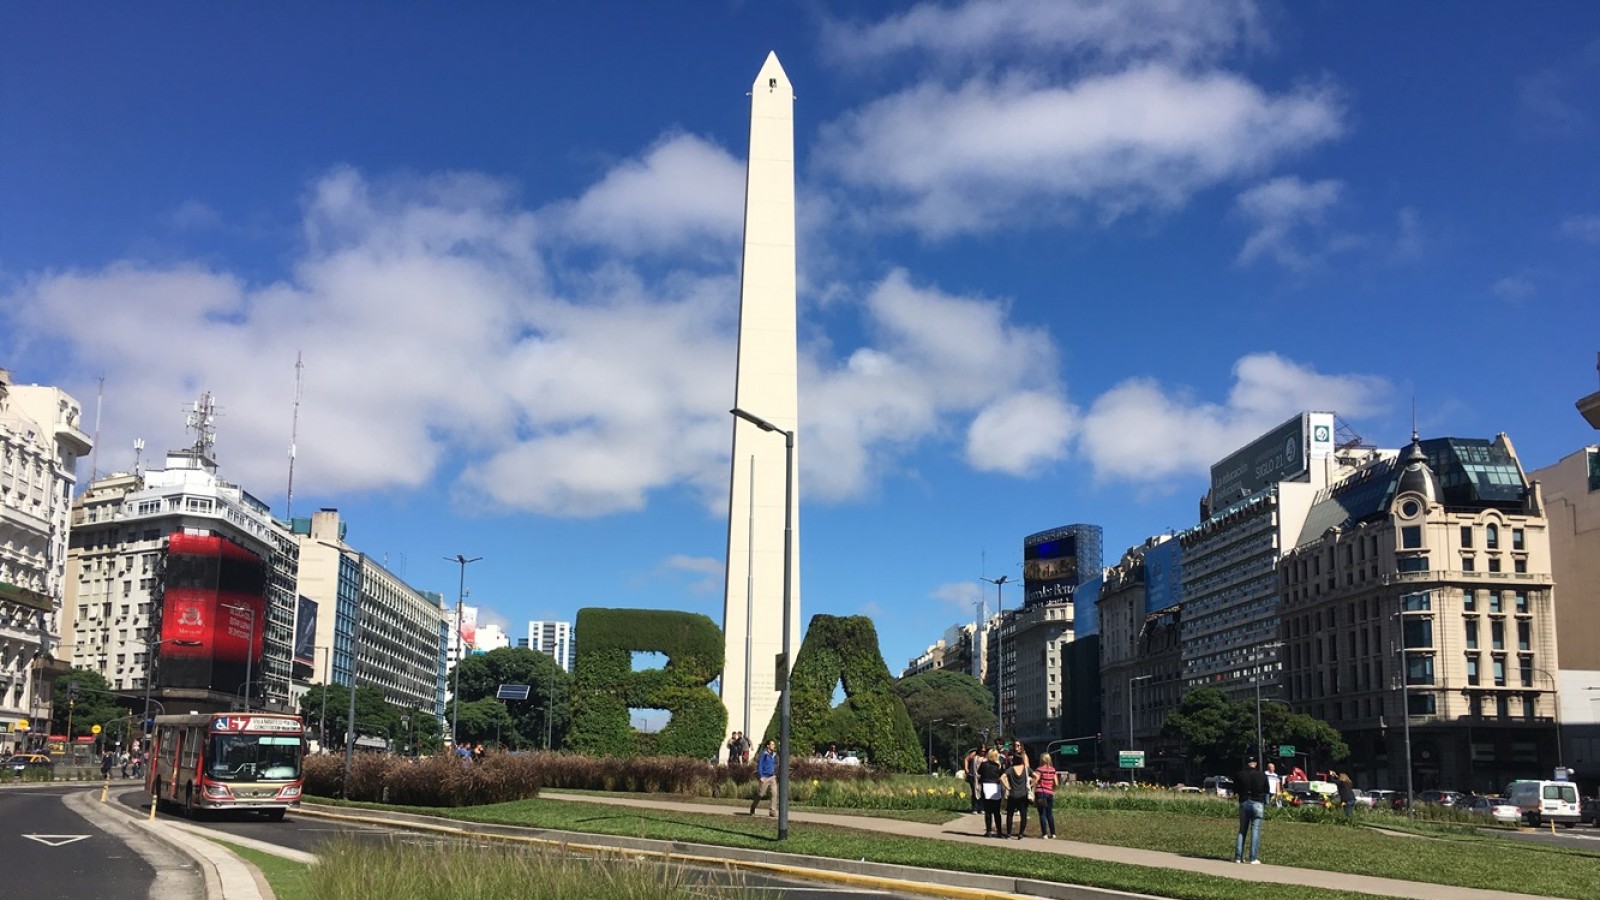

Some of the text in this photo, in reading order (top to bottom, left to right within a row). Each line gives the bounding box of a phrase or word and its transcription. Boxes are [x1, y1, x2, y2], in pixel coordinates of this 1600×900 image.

[1256, 459, 1274, 479] SIGLO
[1275, 454, 1283, 469] 21
[229, 716, 251, 731] 67
